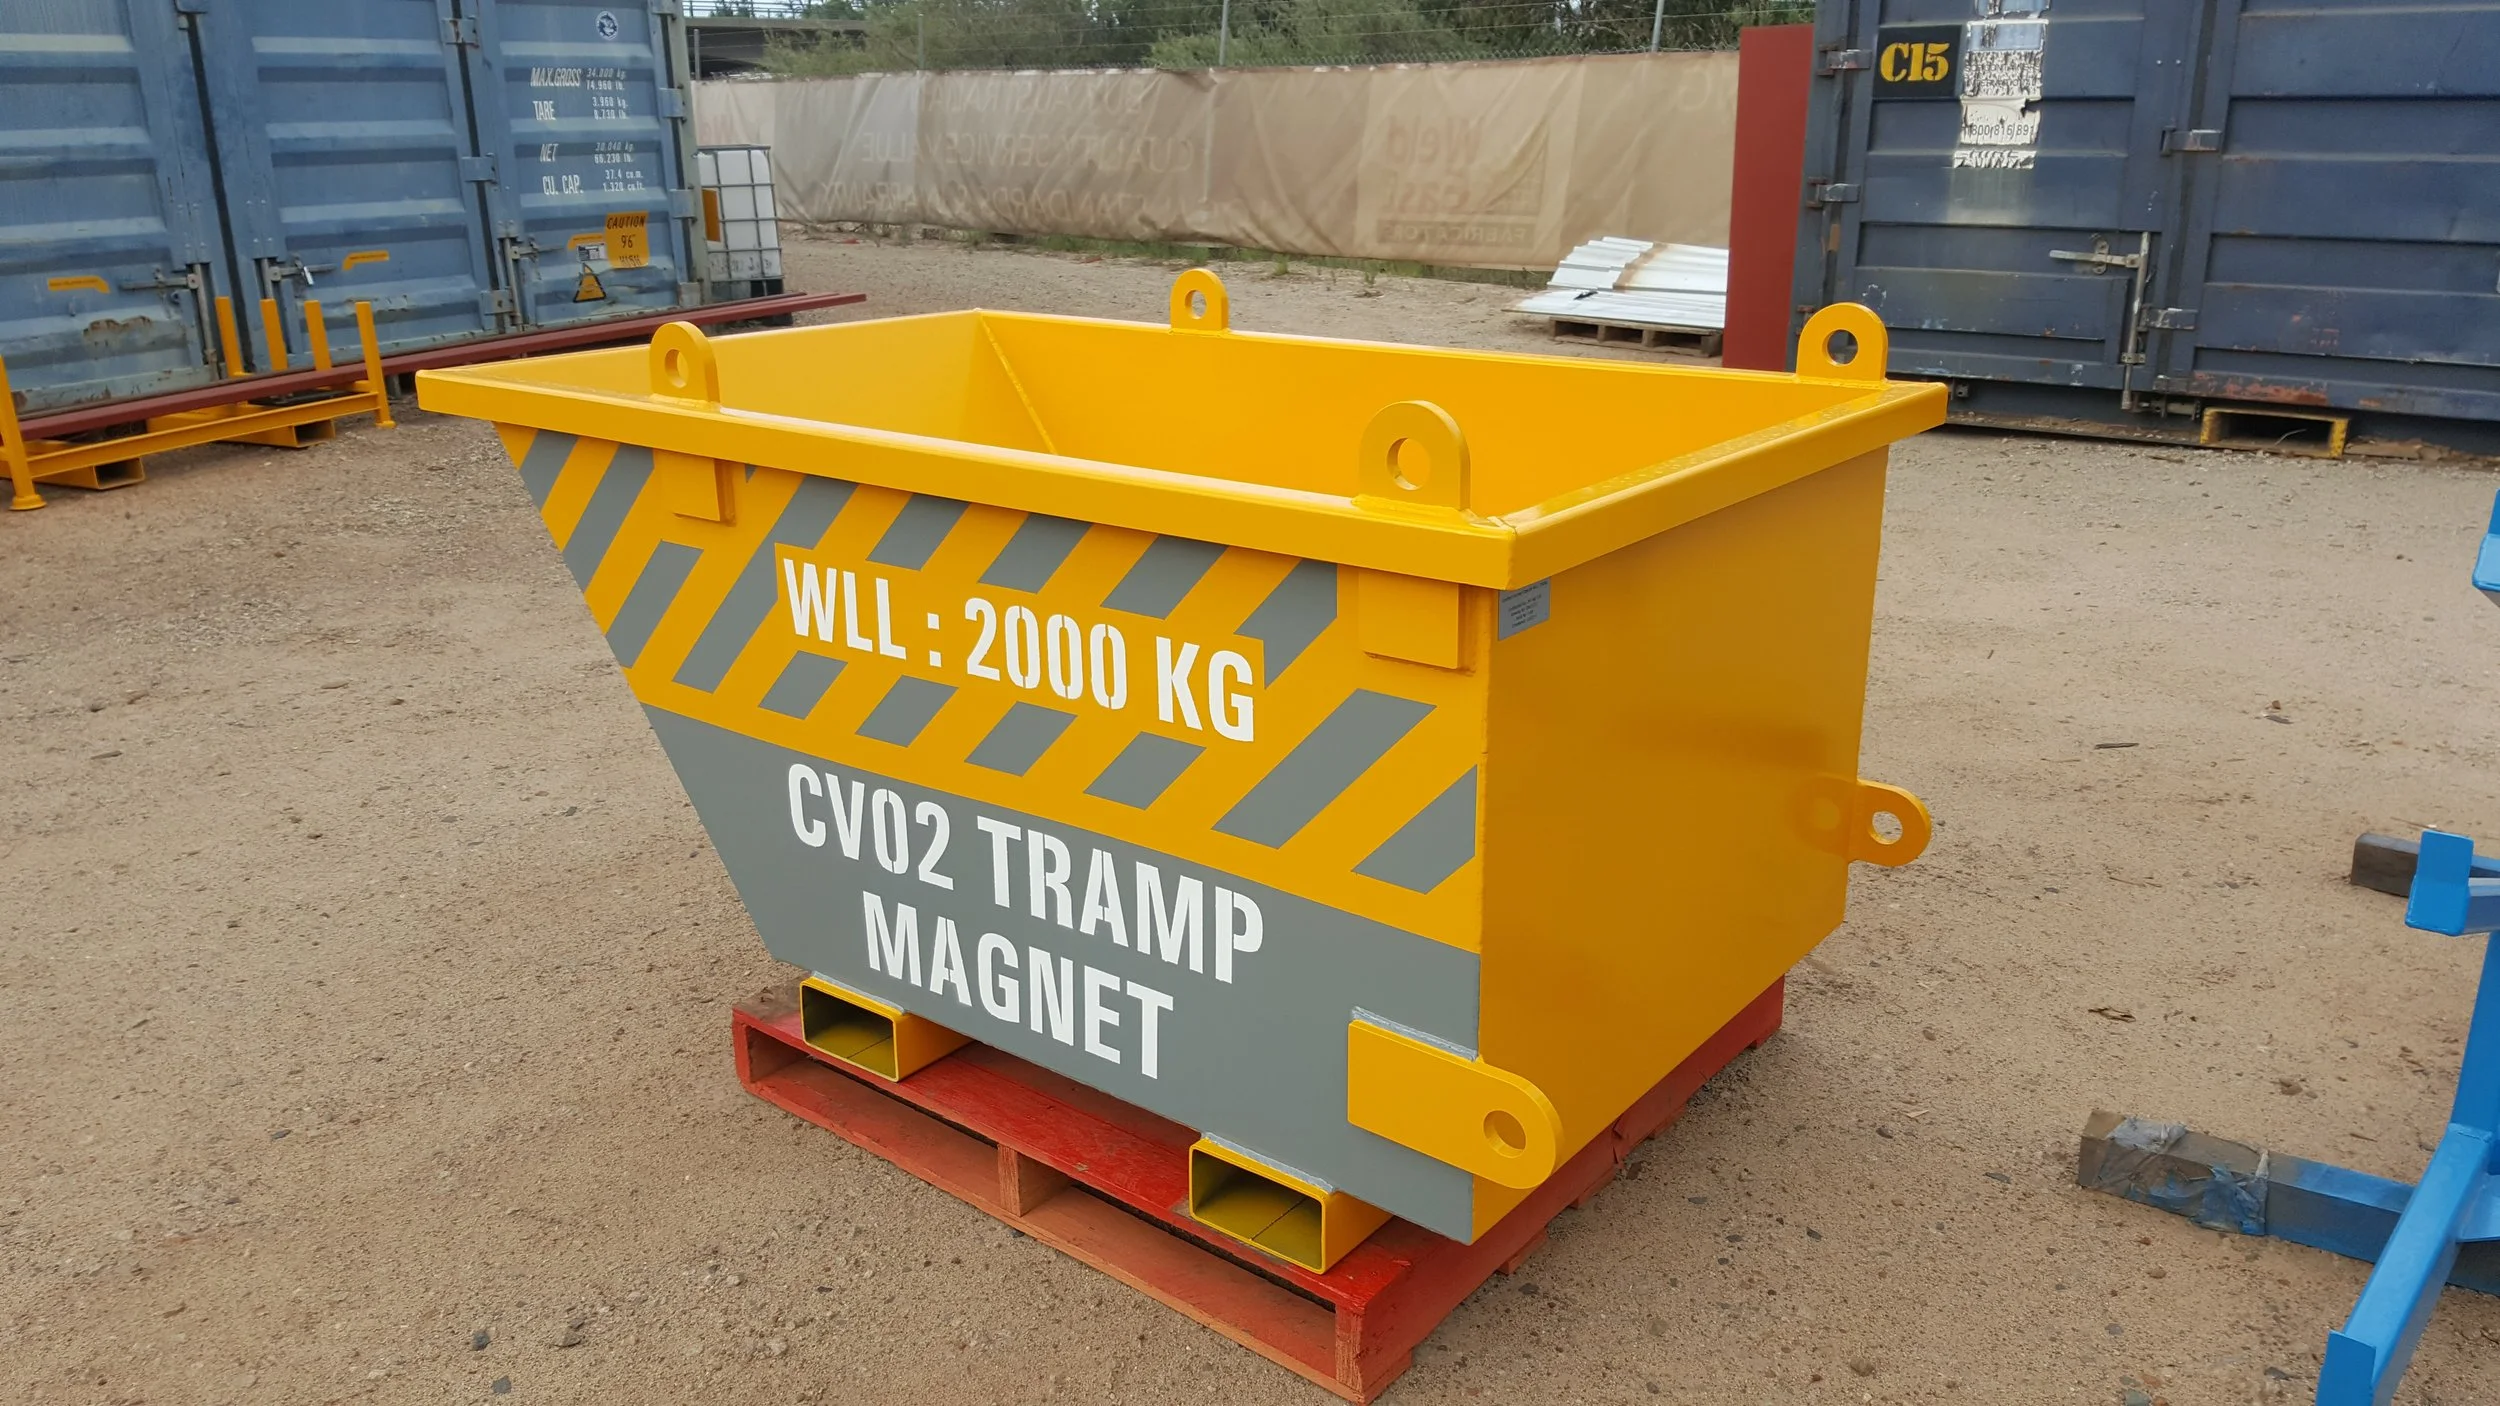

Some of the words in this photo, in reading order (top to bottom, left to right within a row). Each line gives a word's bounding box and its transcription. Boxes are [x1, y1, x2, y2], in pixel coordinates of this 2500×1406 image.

[1880, 42, 1950, 82] C15
[532, 100, 557, 121] TARE
[540, 142, 560, 163] NET
[542, 174, 559, 195] CU.
[561, 174, 584, 195] CAP.
[606, 216, 646, 230] CAUTION
[782, 558, 908, 659] WLL
[926, 612, 943, 669] :
[964, 596, 1128, 711] 2000
[1156, 635, 1256, 743] KG
[787, 763, 955, 892] CV02
[977, 815, 1266, 985] TRAMP
[862, 891, 1175, 1081] MAGNET
